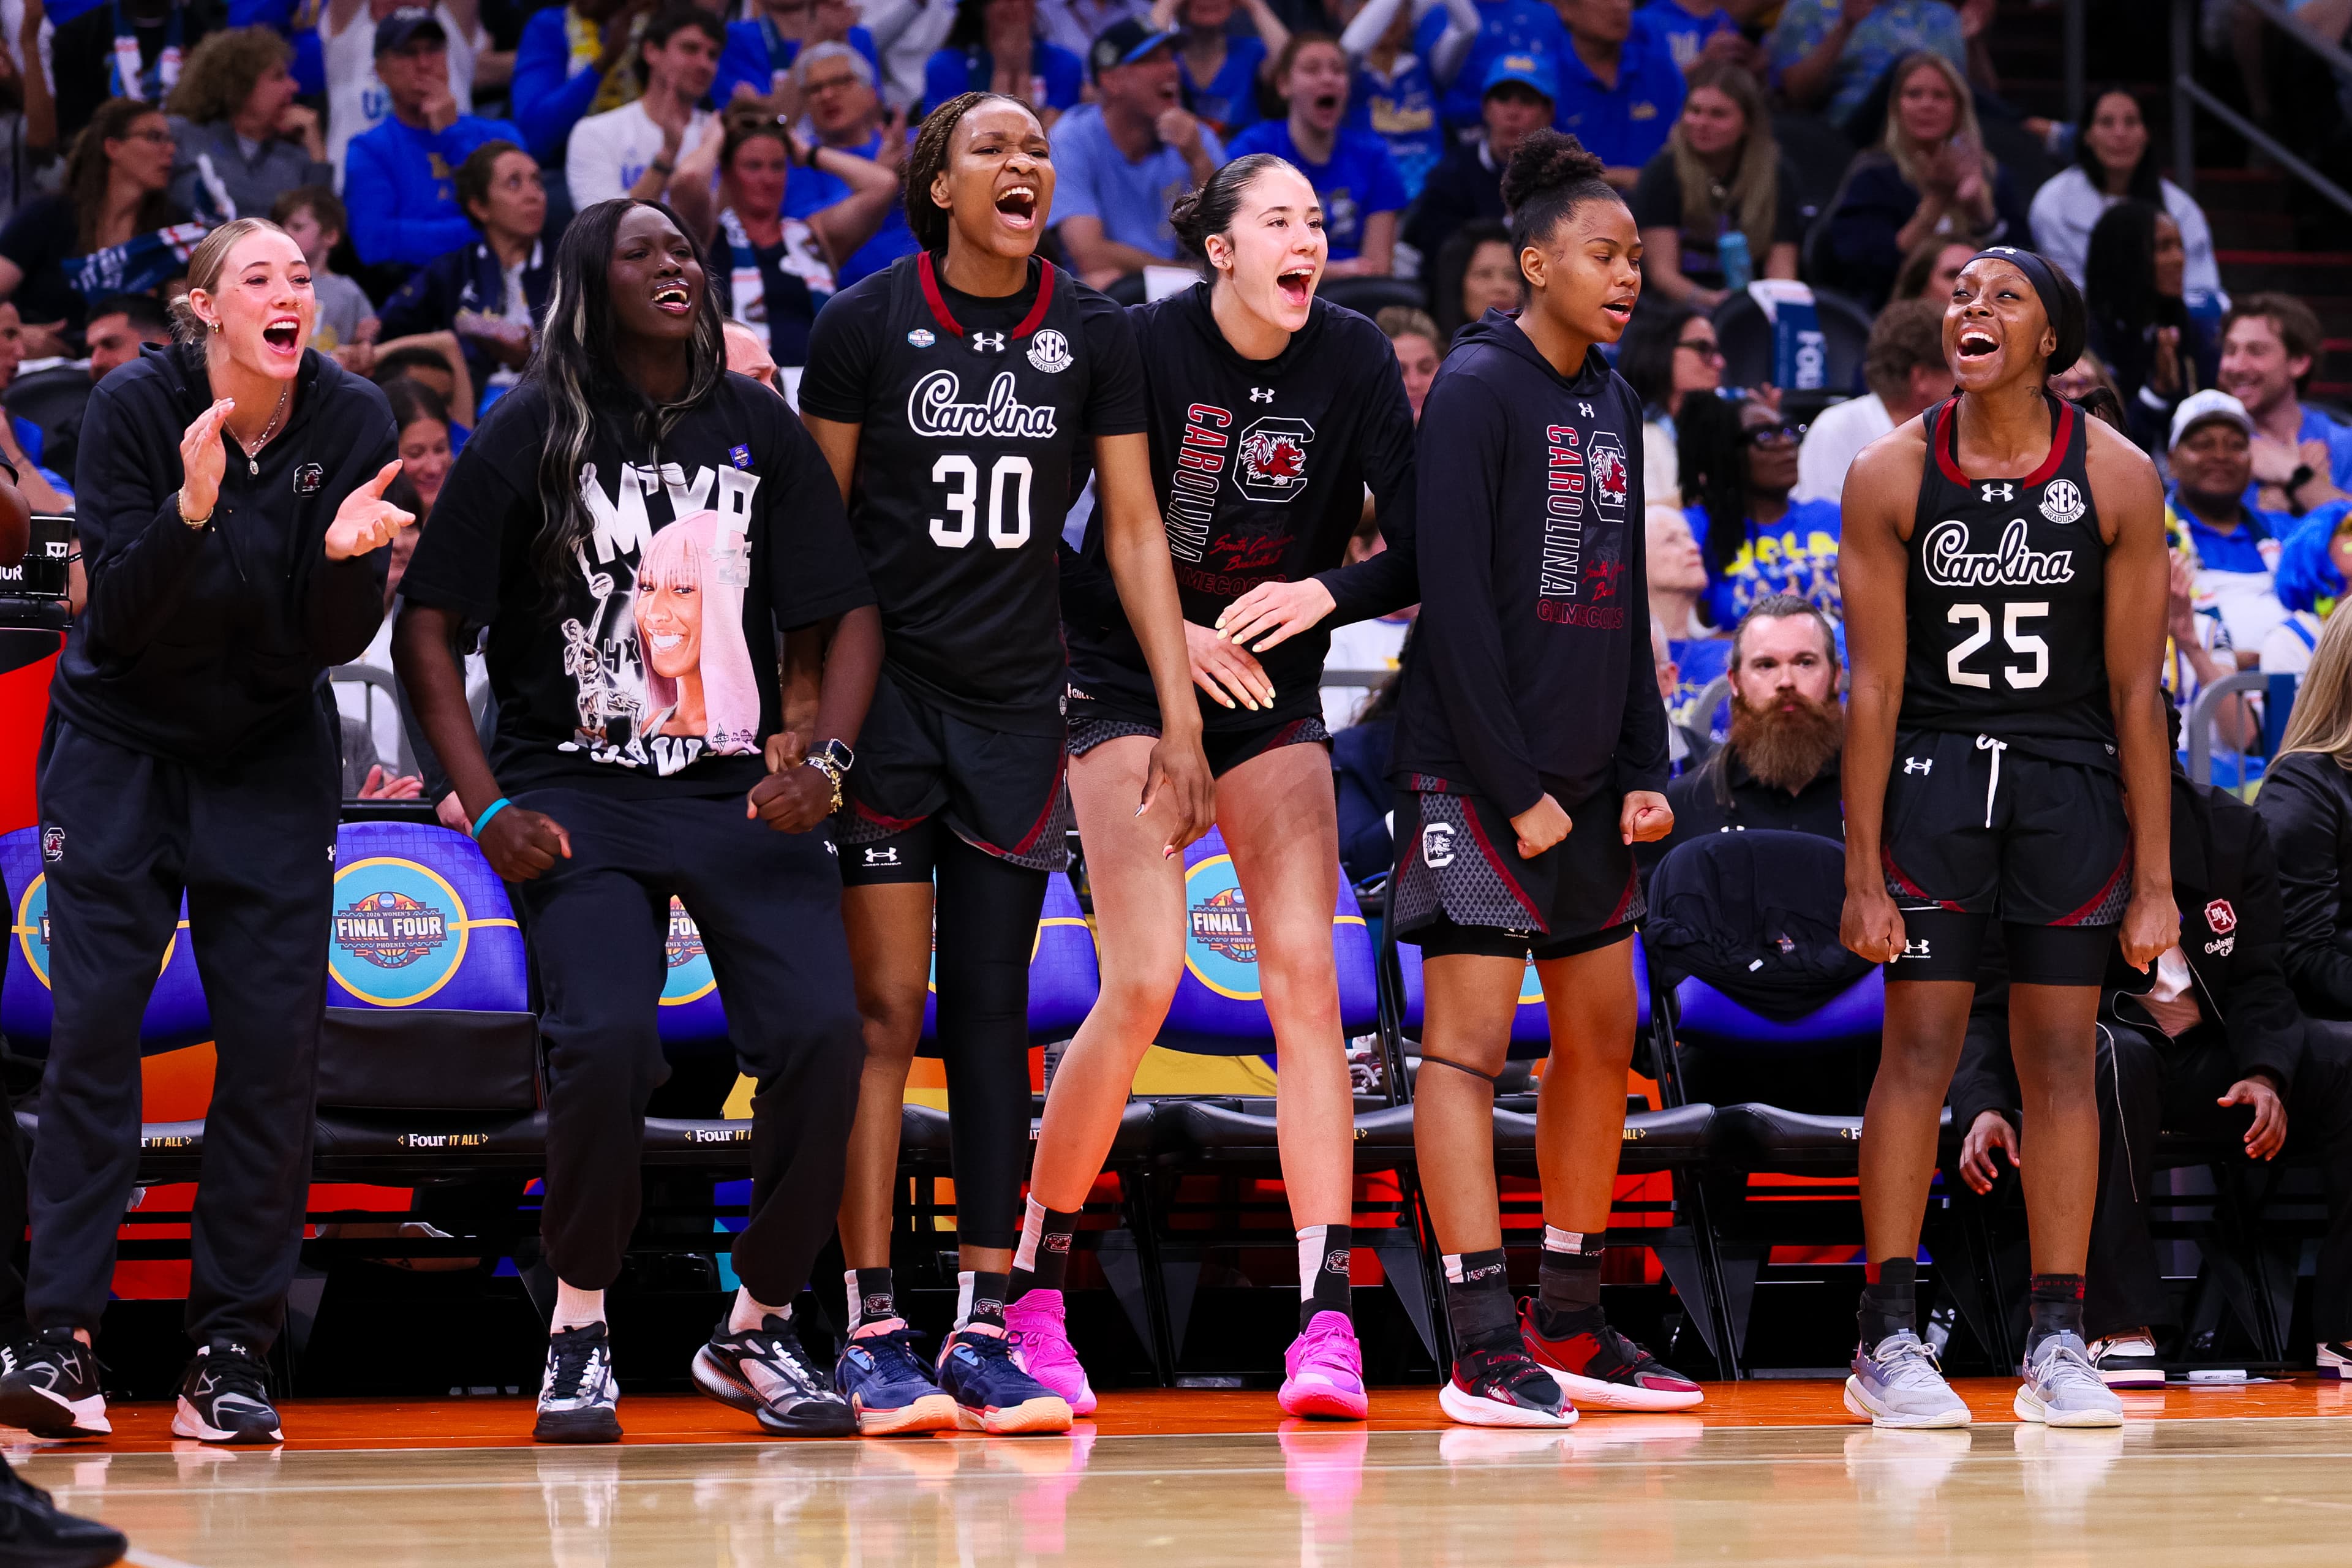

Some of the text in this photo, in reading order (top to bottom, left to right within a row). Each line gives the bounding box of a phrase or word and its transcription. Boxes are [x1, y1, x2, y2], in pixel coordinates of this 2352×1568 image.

[1036, 331, 1065, 362] SEC
[1030, 356, 1067, 372] GRADUATE
[908, 370, 1057, 438] Carolina
[1164, 403, 1232, 562] CAROLINA
[929, 455, 1033, 548] 30
[1540, 424, 1585, 596] CAROLINA
[2048, 482, 2077, 513] SEC
[2043, 509, 2081, 522] GRADUATE
[1923, 518, 2075, 586] Carolina
[0, 564, 23, 581] UR
[1947, 602, 2049, 688] 25
[337, 916, 442, 937] FINAL FOUR
[1193, 913, 1242, 932] FINAL
[152, 1137, 162, 1147] IT
[164, 1137, 183, 1147] ALL
[409, 1133, 479, 1147] Four IT ALL
[696, 1129, 733, 1142] Four
[736, 1129, 745, 1140] IT
